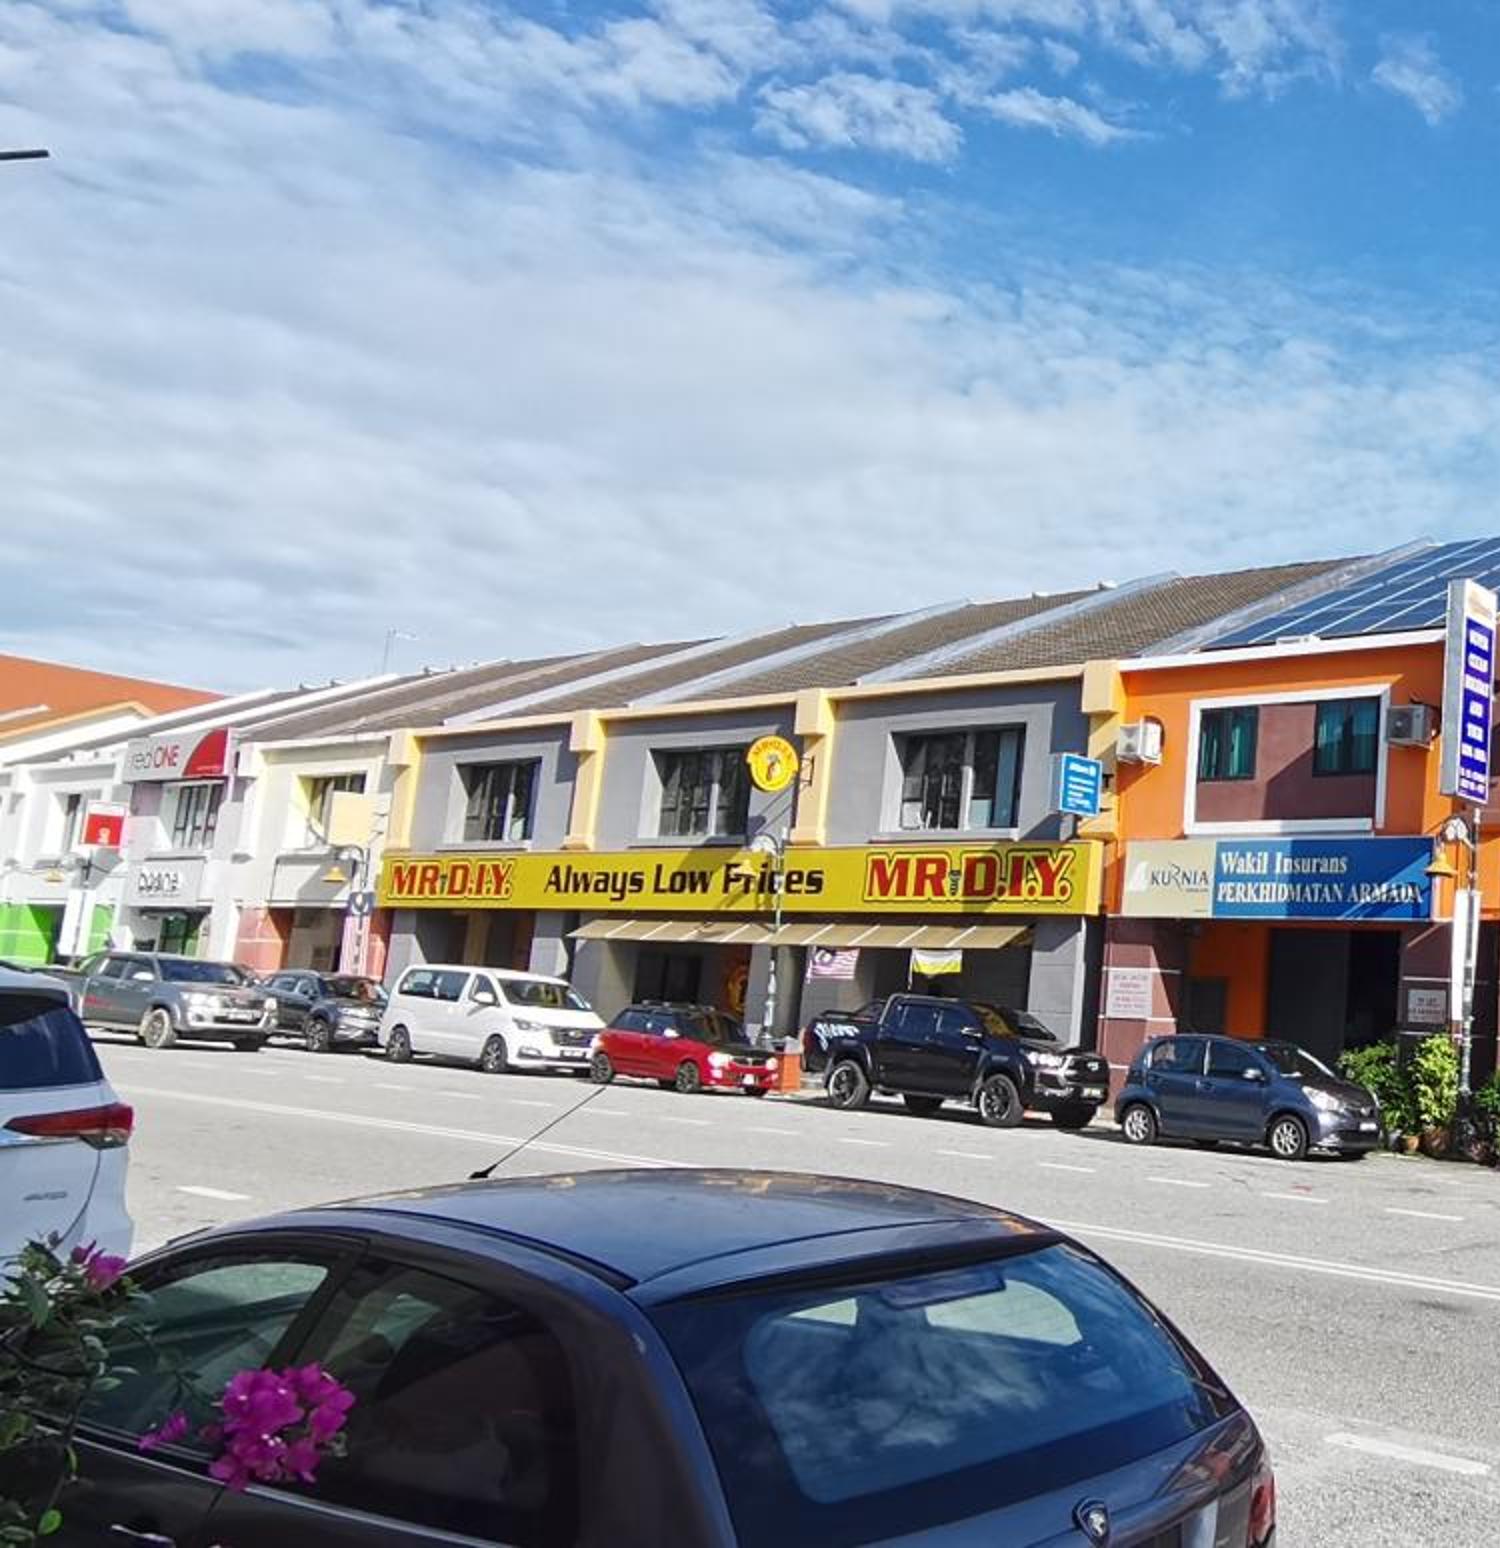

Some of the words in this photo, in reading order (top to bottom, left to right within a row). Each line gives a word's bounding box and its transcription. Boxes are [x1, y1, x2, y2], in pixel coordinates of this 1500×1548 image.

[1221, 851, 1268, 875] Wakil
[1275, 852, 1348, 875] Insurans
[544, 864, 645, 902] Always
[653, 863, 712, 894] Low
[1151, 863, 1209, 892] KURNIA
[1217, 881, 1343, 904] PERKHIDMATAN
[1347, 882, 1425, 904] ARMADA
